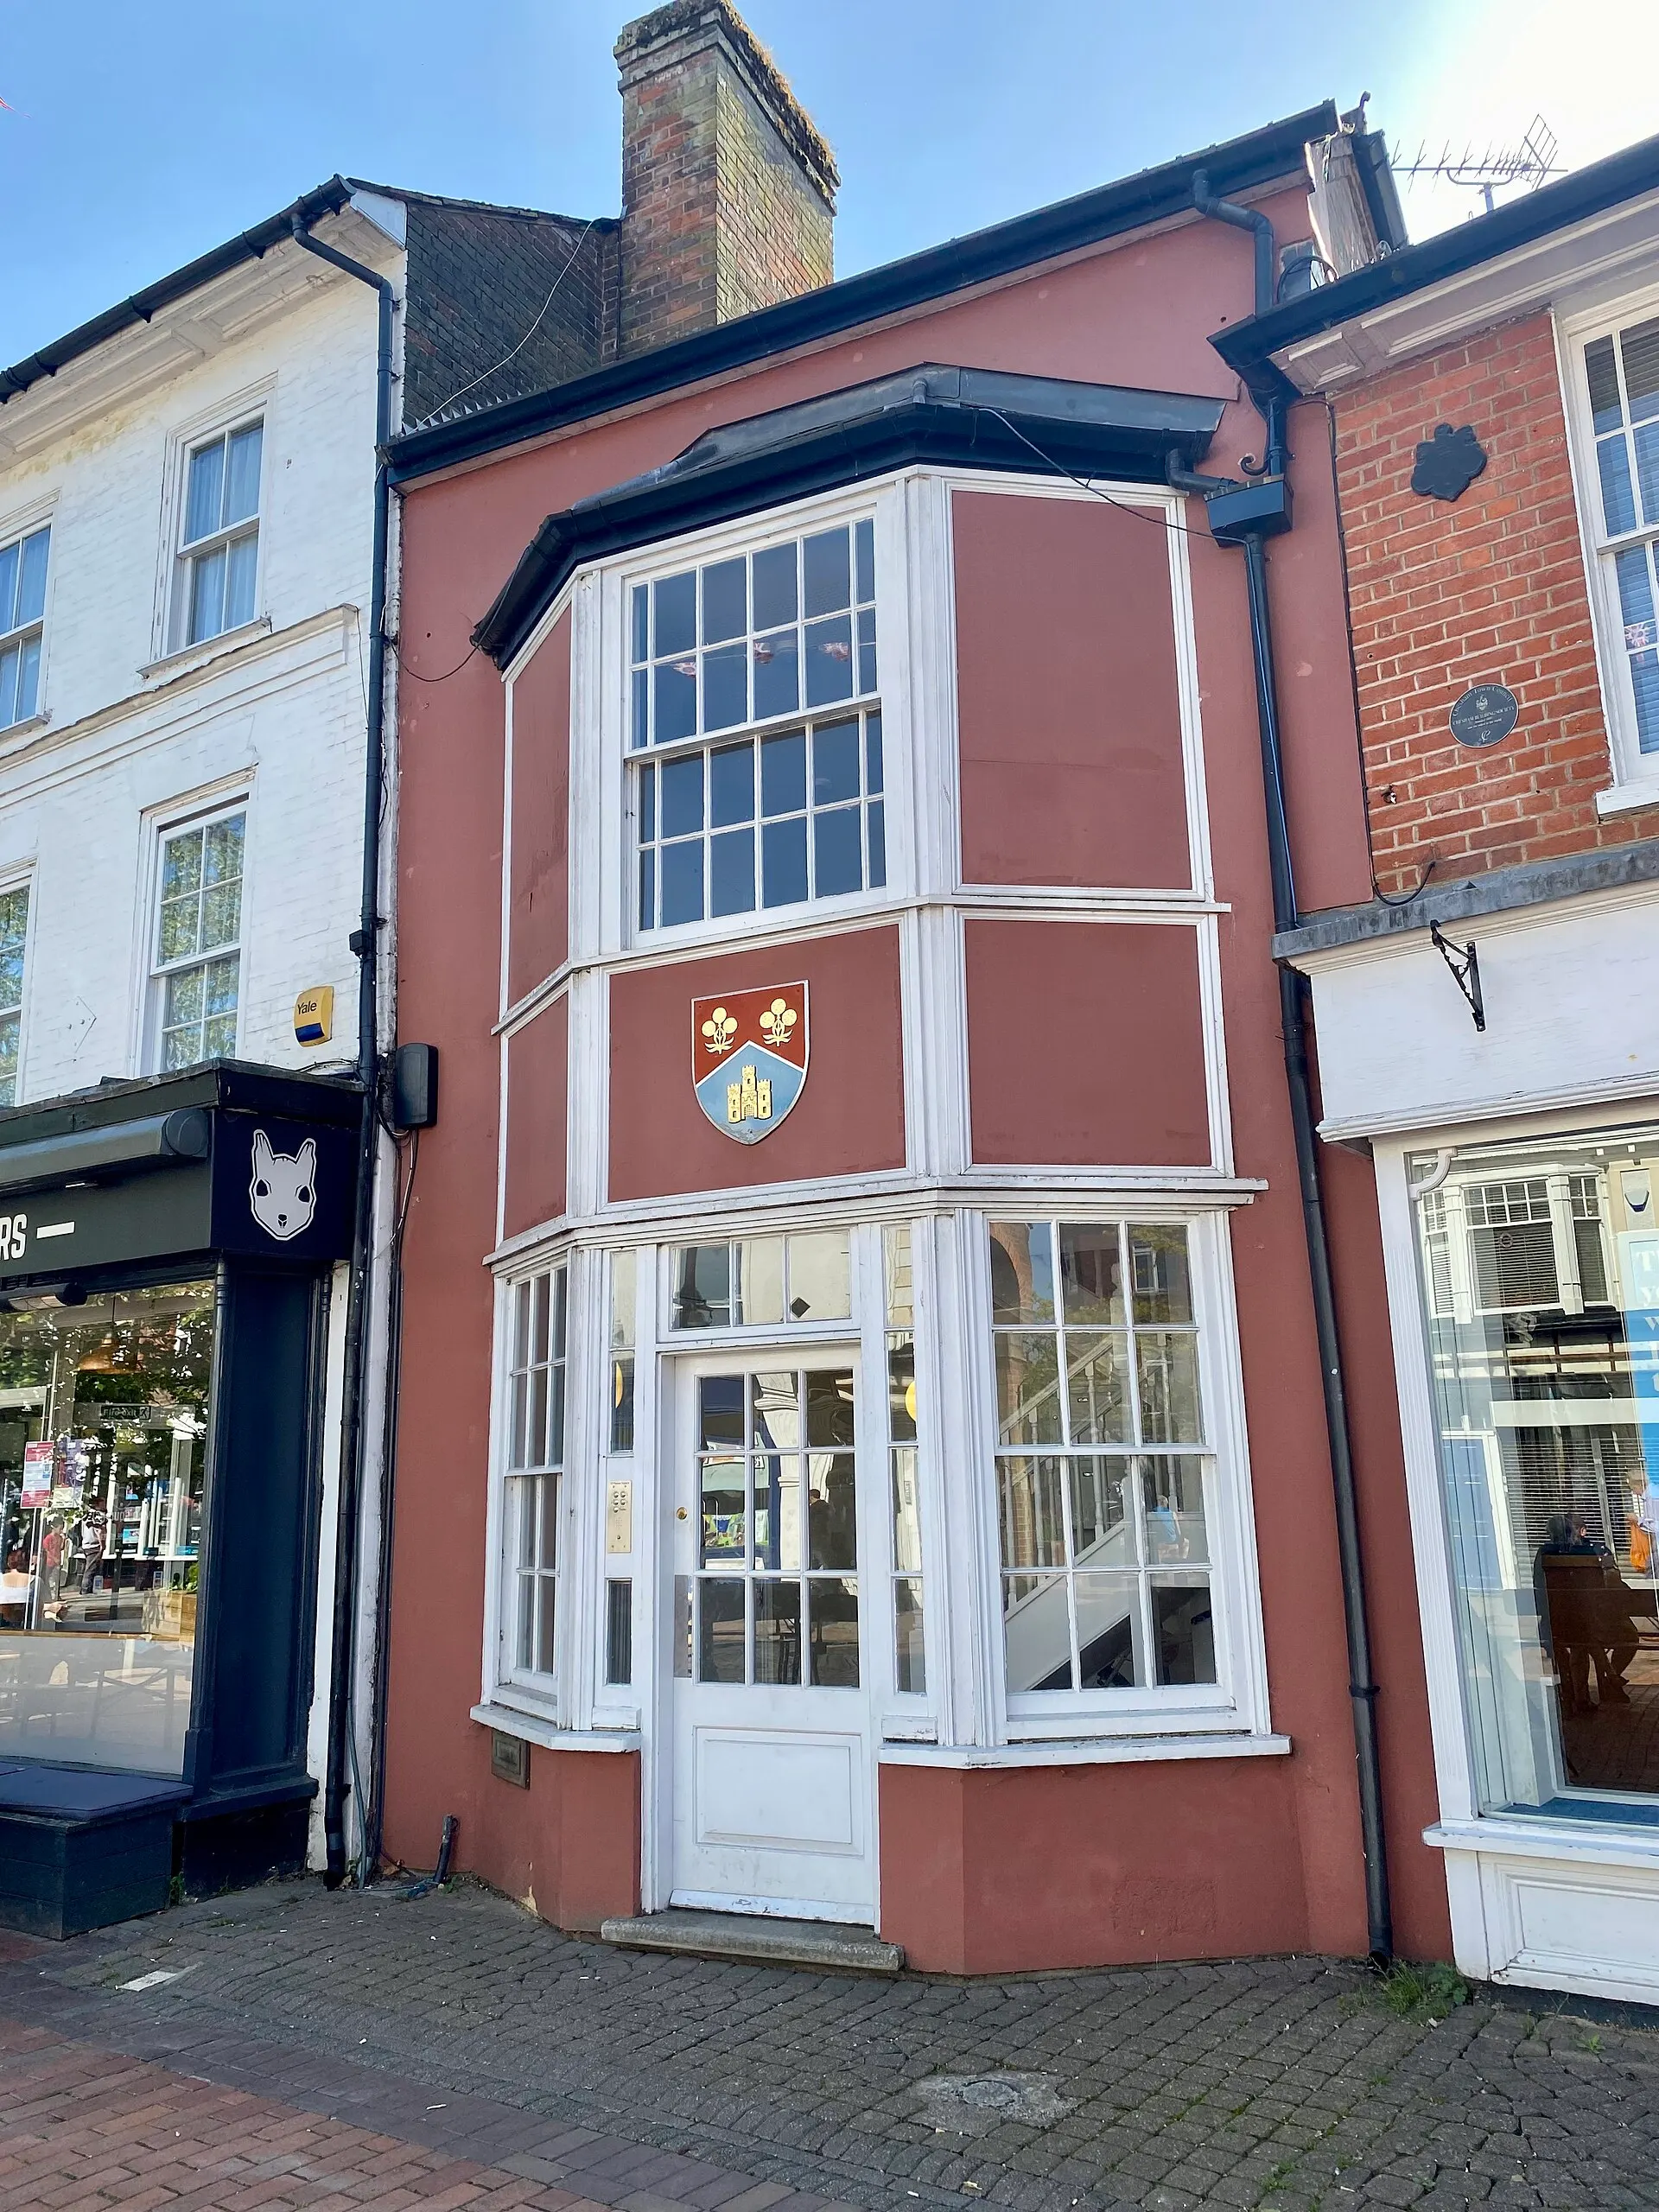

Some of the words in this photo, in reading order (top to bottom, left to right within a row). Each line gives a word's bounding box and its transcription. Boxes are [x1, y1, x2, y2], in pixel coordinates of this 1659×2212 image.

[1452, 693, 1473, 716] Chesham
[1492, 686, 1513, 702] Council
[297, 1001, 317, 1014] Yale
[104, 1408, 120, 1416] Fire
[121, 1407, 138, 1417] exit
